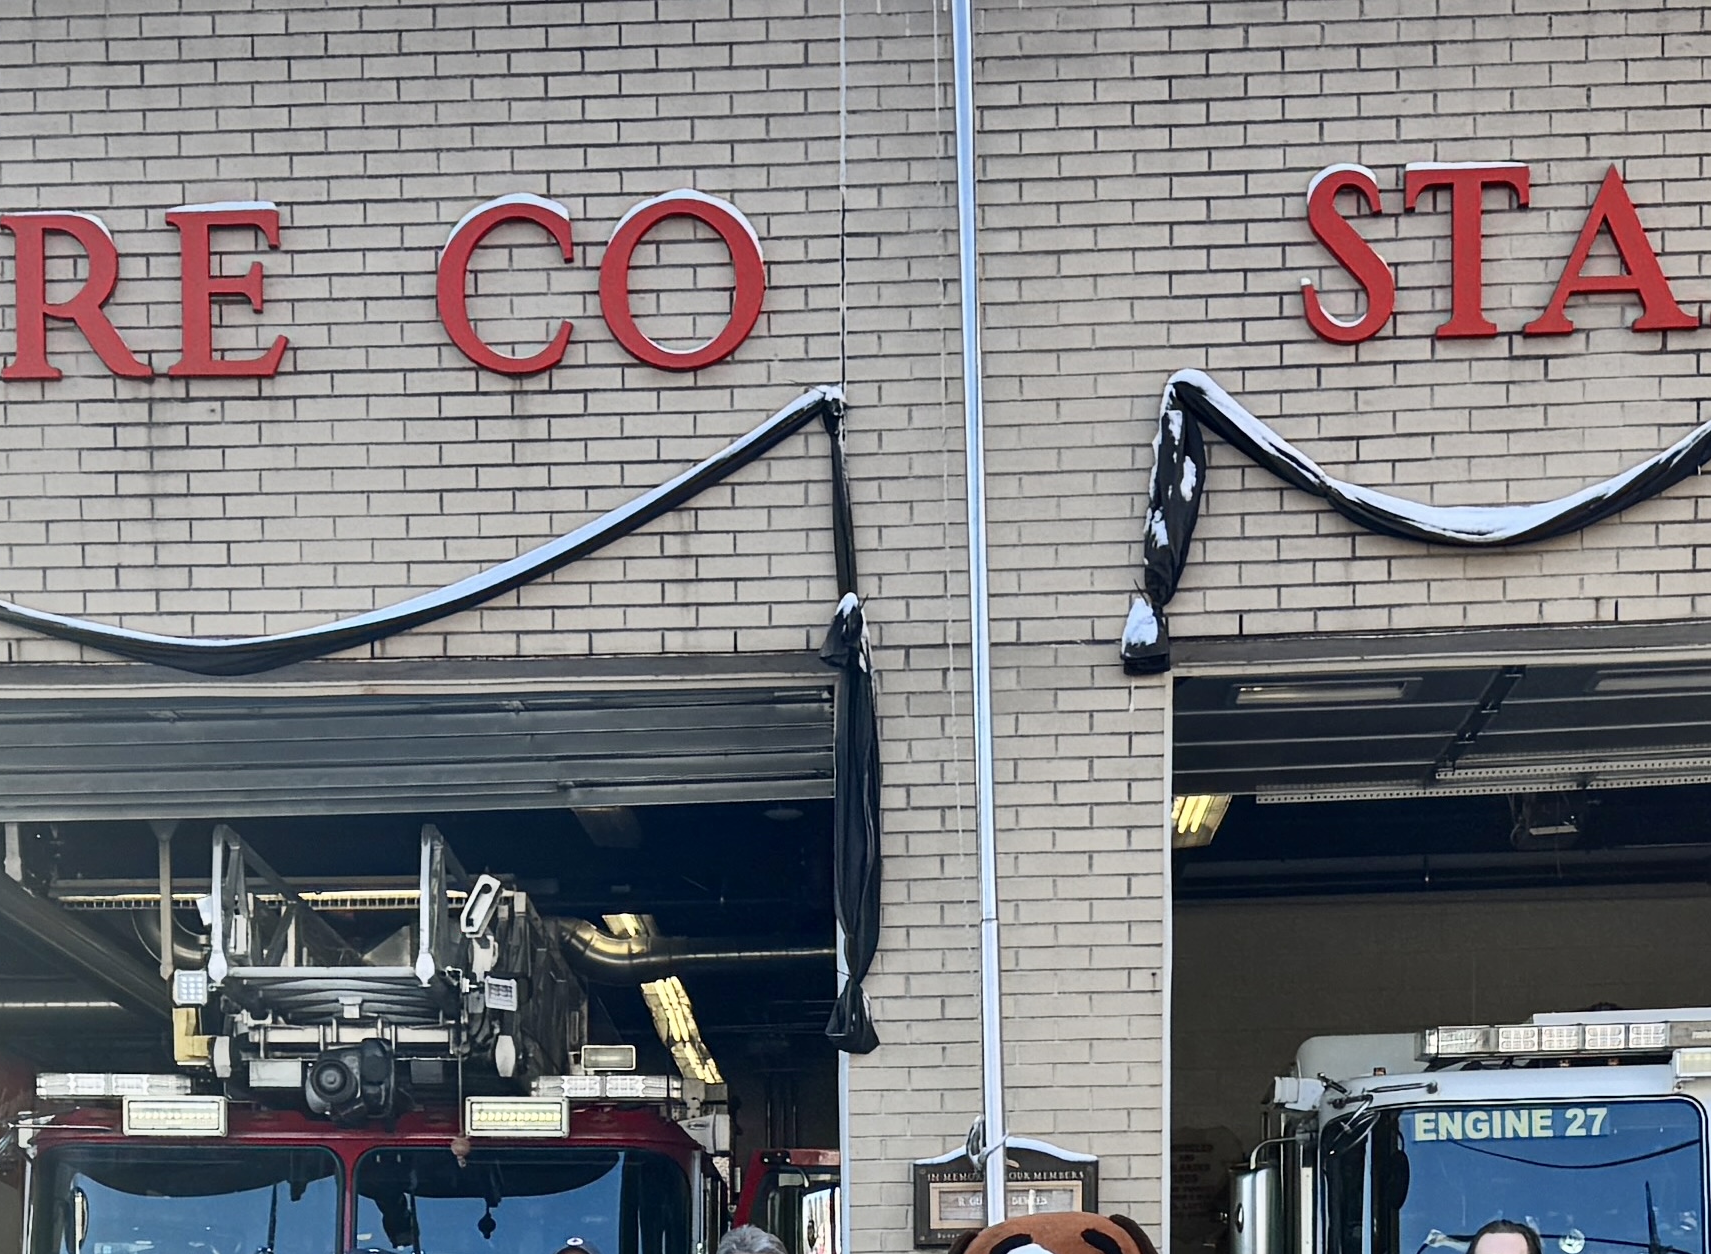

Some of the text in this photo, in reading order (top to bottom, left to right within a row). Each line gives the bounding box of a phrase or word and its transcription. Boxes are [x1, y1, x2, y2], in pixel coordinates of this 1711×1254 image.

[436, 190, 767, 374] CO
[1414, 1107, 1608, 1141] ENGINE 27
[1033, 1170, 1084, 1181] MEMBERS
